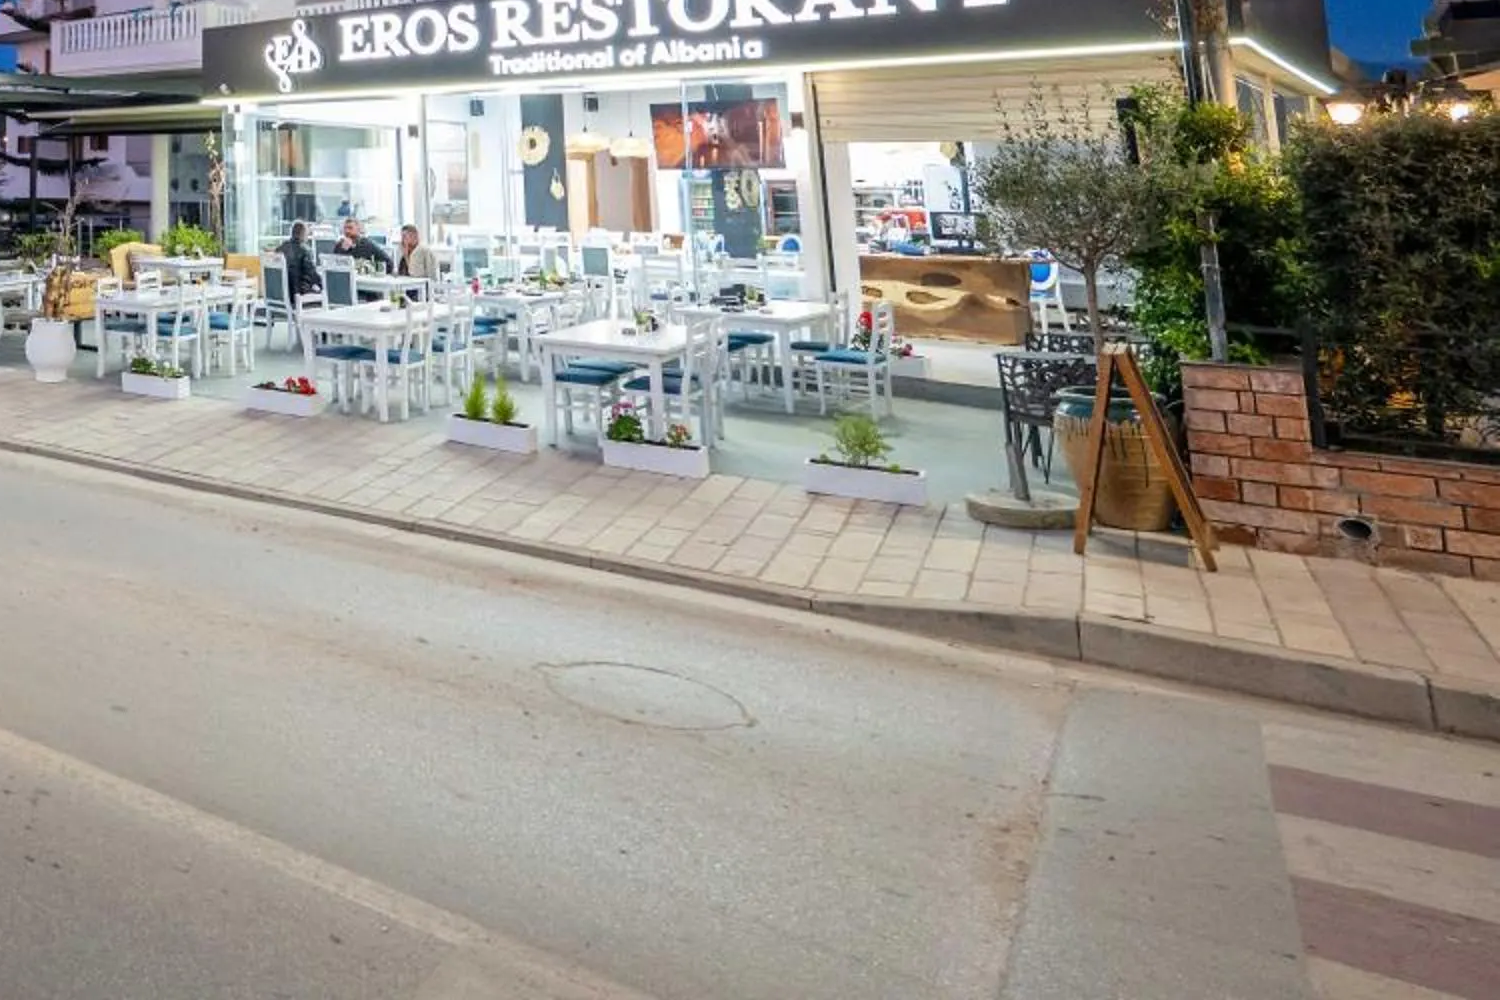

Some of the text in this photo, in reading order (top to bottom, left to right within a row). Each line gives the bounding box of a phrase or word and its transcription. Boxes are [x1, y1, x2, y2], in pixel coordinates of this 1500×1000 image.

[338, 4, 480, 61] EROS
[489, 36, 764, 76] Traditional of Albania
